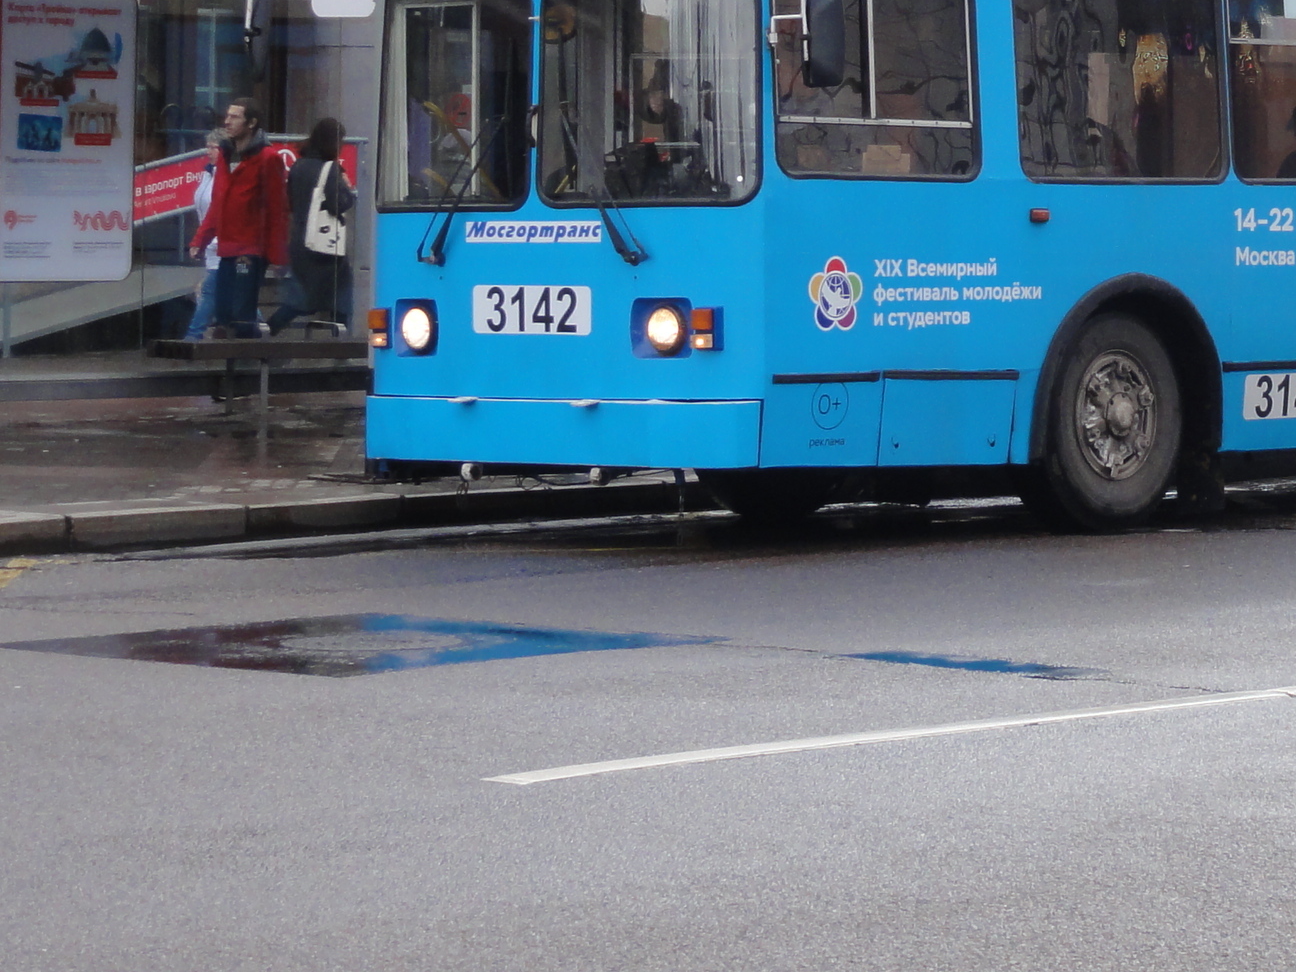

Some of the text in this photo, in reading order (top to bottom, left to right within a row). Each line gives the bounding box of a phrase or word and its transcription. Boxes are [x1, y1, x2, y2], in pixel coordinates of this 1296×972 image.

[466, 221, 602, 243] Мосгортранс
[1235, 246, 1295, 266] Москва
[907, 257, 997, 280] Всемирный
[873, 281, 1042, 306] фестиваль молодёжи
[486, 286, 577, 333] 3142
[873, 309, 971, 330] и студентов
[809, 438, 845, 448] реклама
